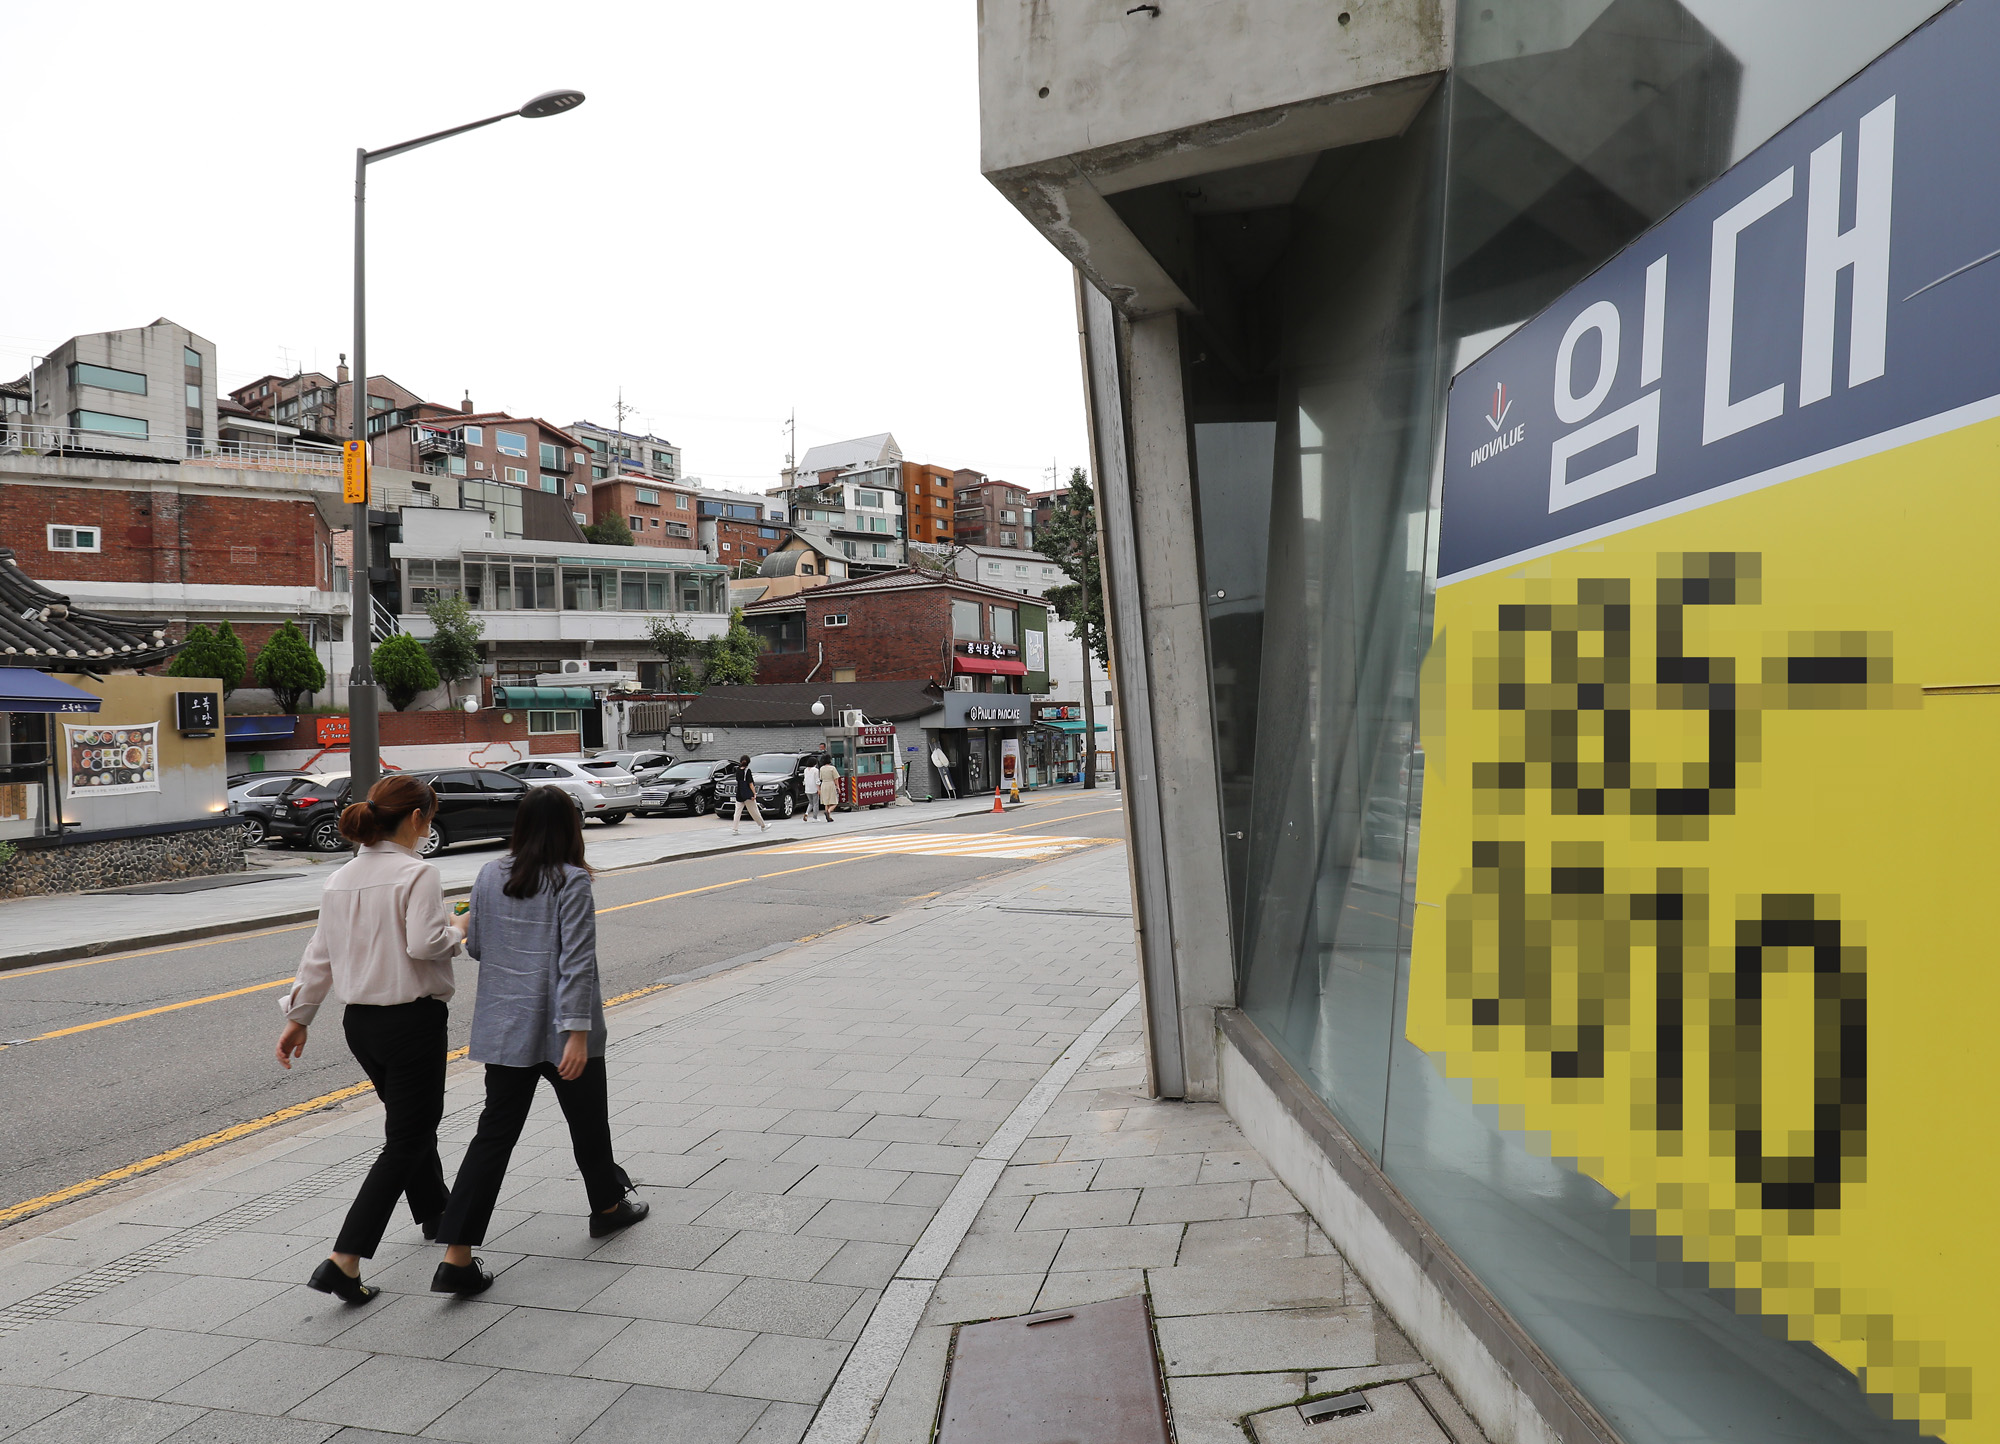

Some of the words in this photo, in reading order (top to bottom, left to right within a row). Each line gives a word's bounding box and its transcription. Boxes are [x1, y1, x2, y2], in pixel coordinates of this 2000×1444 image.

[1548, 95, 1896, 514] 임대
[1471, 423, 1525, 468] INOVALUE
[967, 642, 990, 656] 중식당
[978, 706, 997, 720] PAULIN
[997, 708, 1020, 720] PANCAKE
